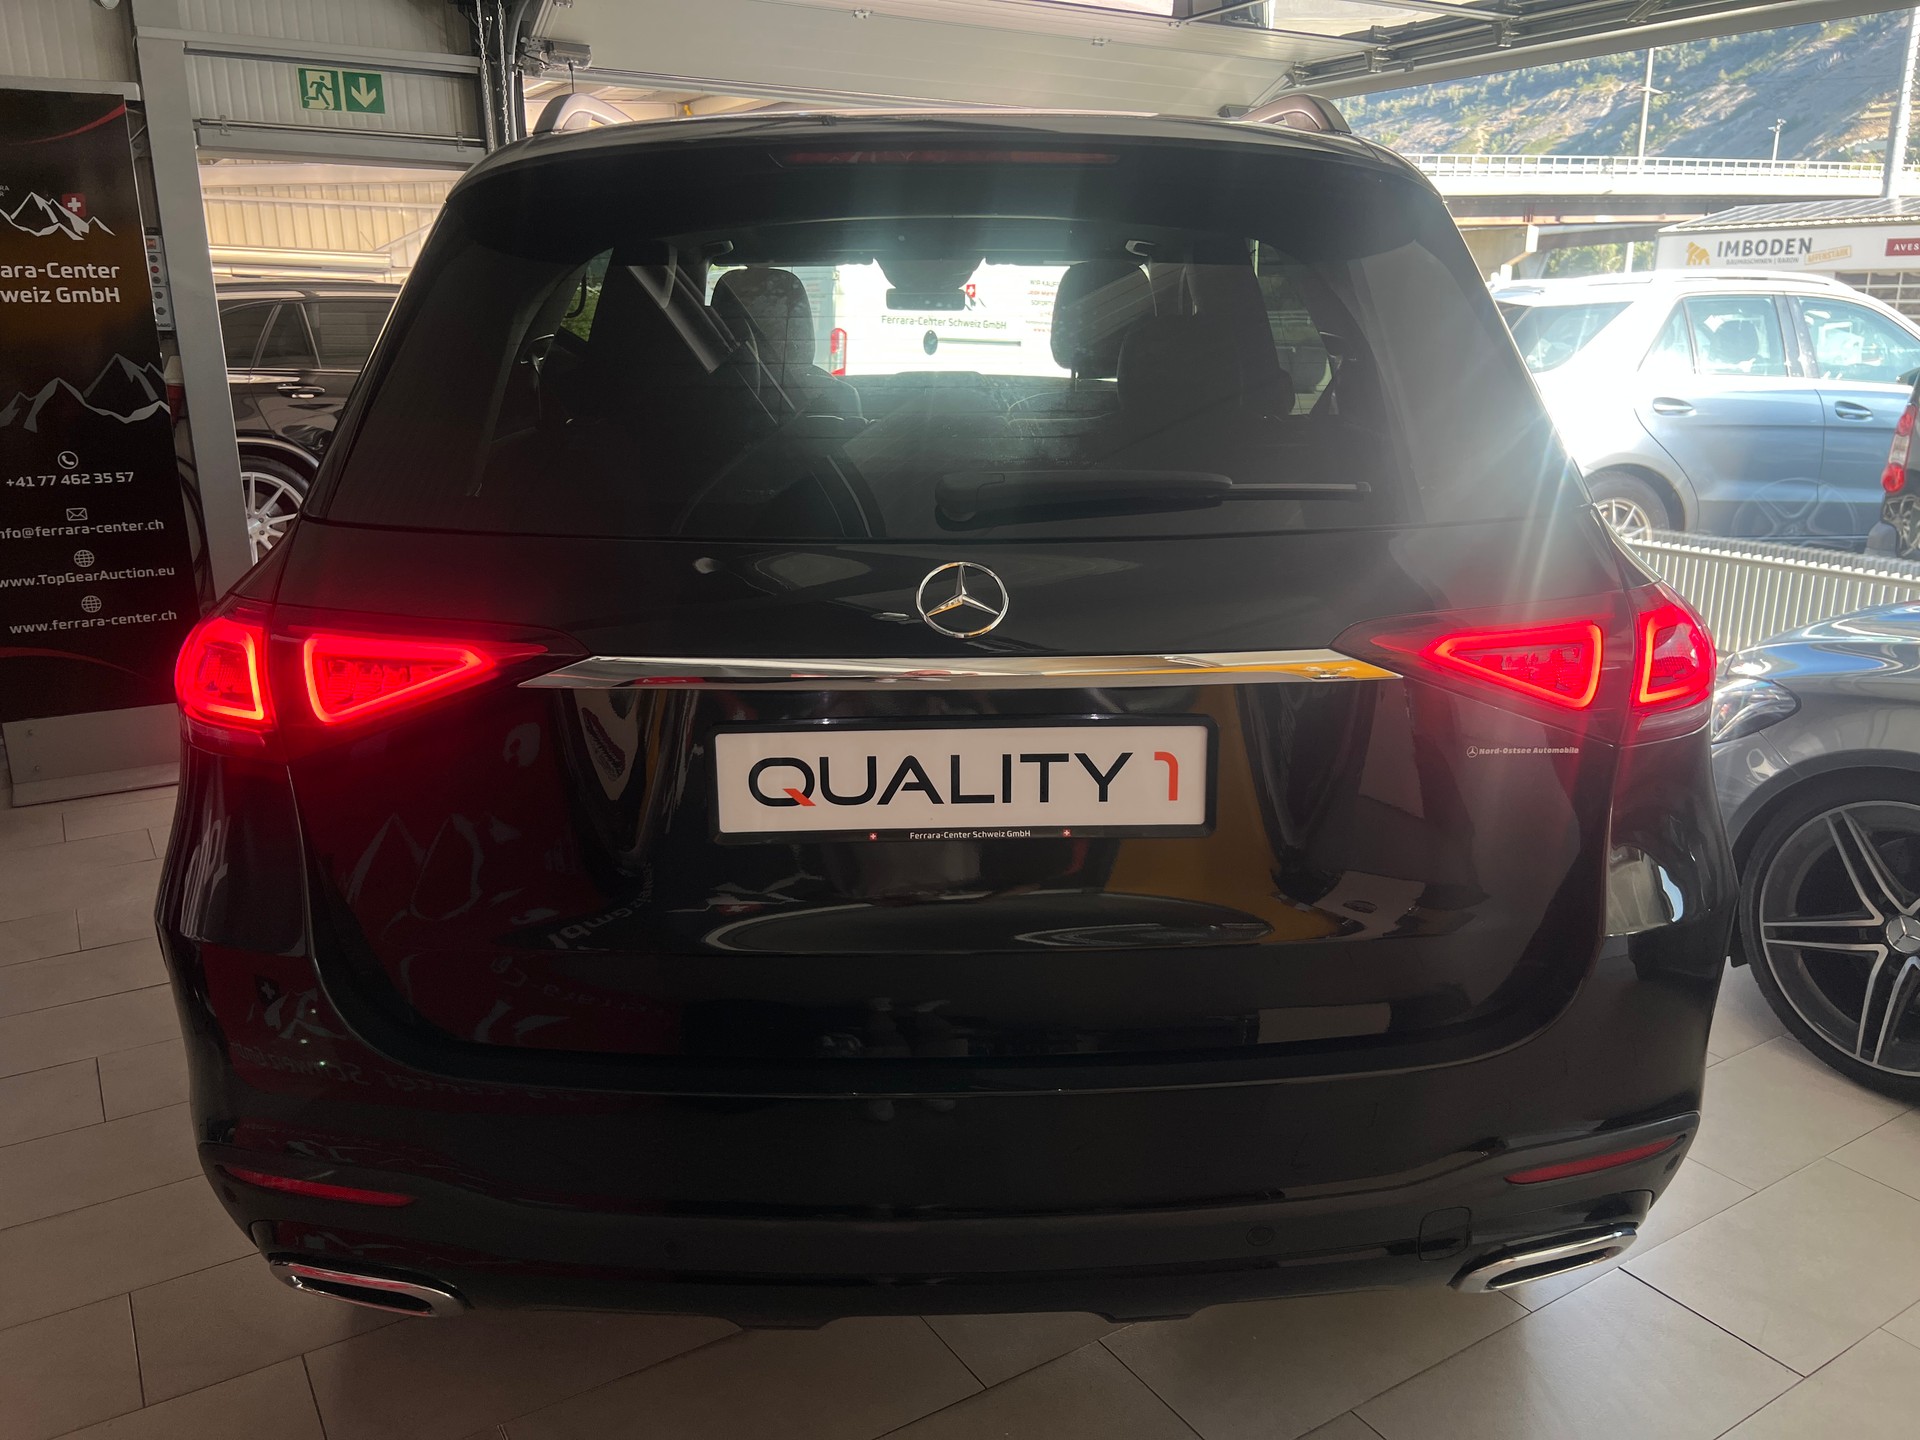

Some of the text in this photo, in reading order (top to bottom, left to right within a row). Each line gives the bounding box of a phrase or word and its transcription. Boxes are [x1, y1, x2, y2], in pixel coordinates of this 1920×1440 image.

[1717, 237, 1813, 258] IMBODEN
[0, 262, 120, 279] ara-Center
[0, 286, 121, 303] weiz GmbH
[880, 314, 1007, 330] Ferrara-Center Schweiz GmbH
[37, 475, 57, 487] 77
[60, 474, 91, 485] 462
[93, 472, 113, 484] 35
[115, 471, 134, 483] 57
[0, 566, 175, 588] www.TopGearAuction.eu
[9, 610, 177, 634] www.ferrara-center.ch
[1479, 746, 1580, 755] Nord-Ostsee Automobile
[748, 752, 1134, 807] QUALITY
[909, 829, 1031, 840] Ferrara-Center Schweiz GmbH
